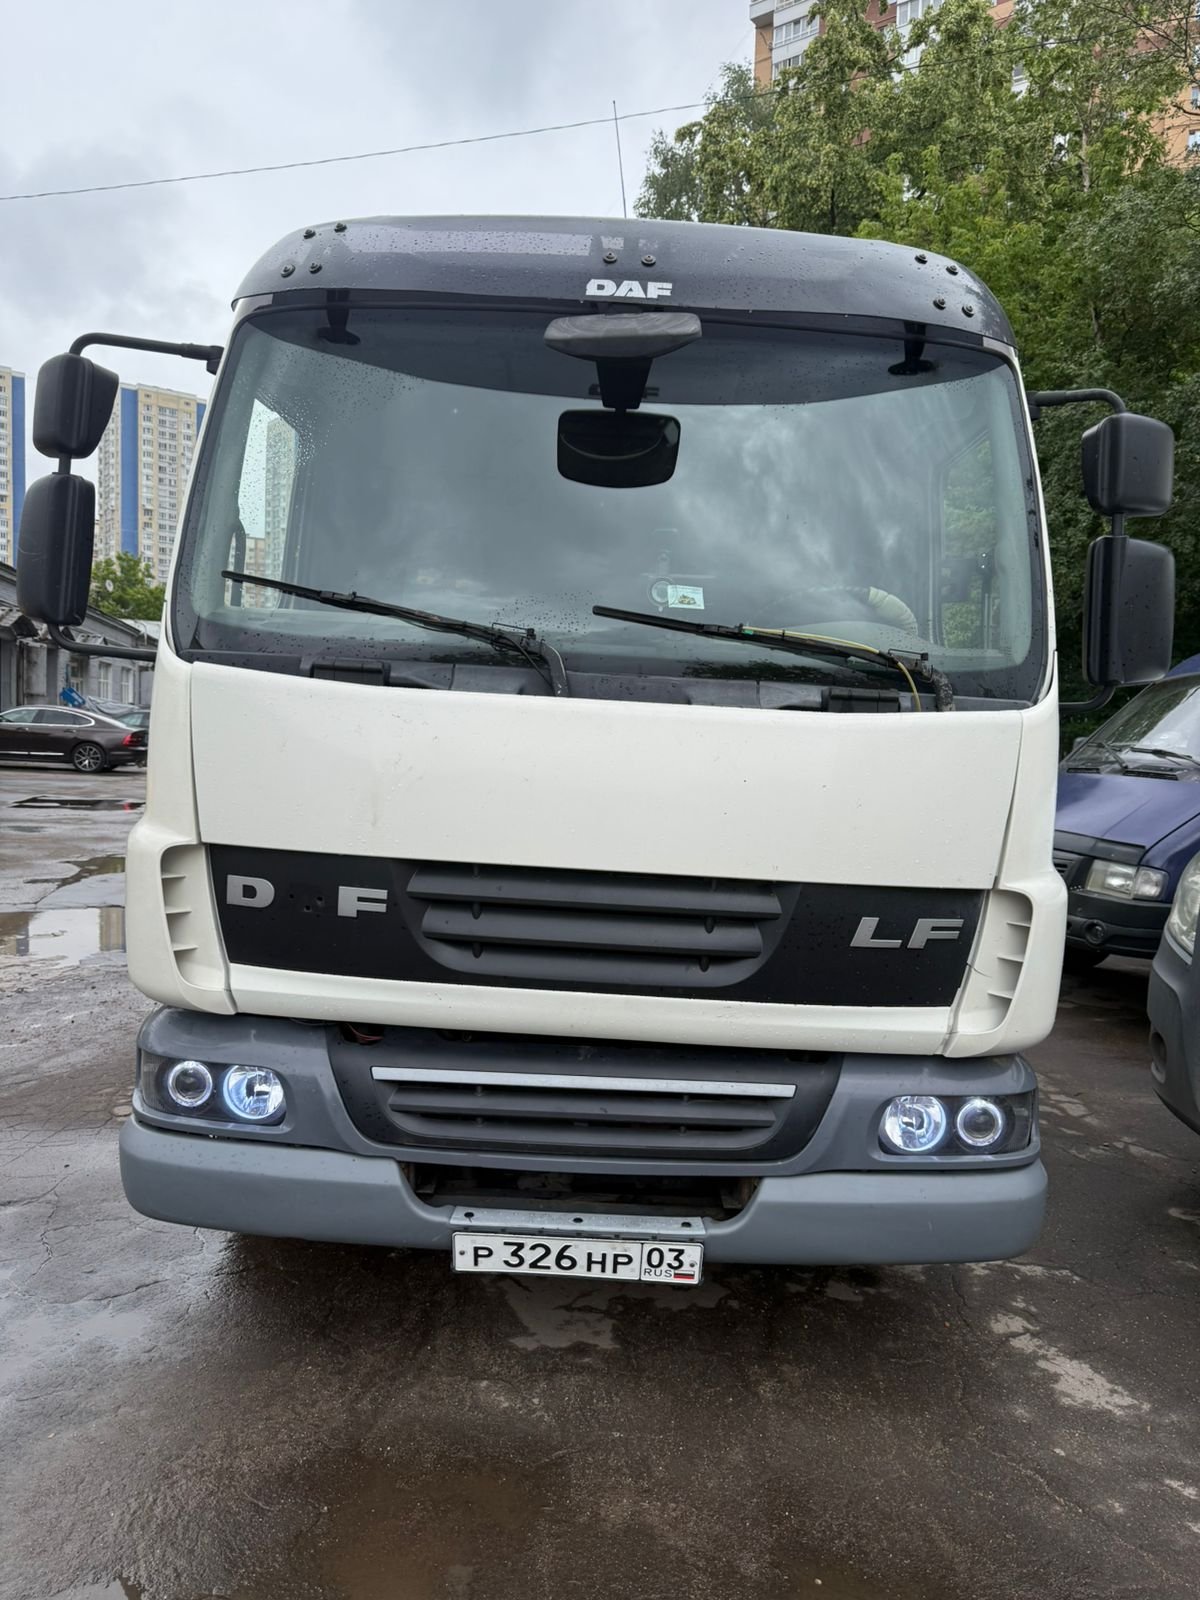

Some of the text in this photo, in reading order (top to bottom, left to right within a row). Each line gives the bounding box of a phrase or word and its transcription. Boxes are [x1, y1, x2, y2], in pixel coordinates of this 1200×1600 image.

[585, 278, 673, 299] DAF
[226, 874, 388, 918] DF
[850, 916, 964, 949] LF
[646, 1247, 685, 1270] 03
[643, 1267, 673, 1279] RUS
